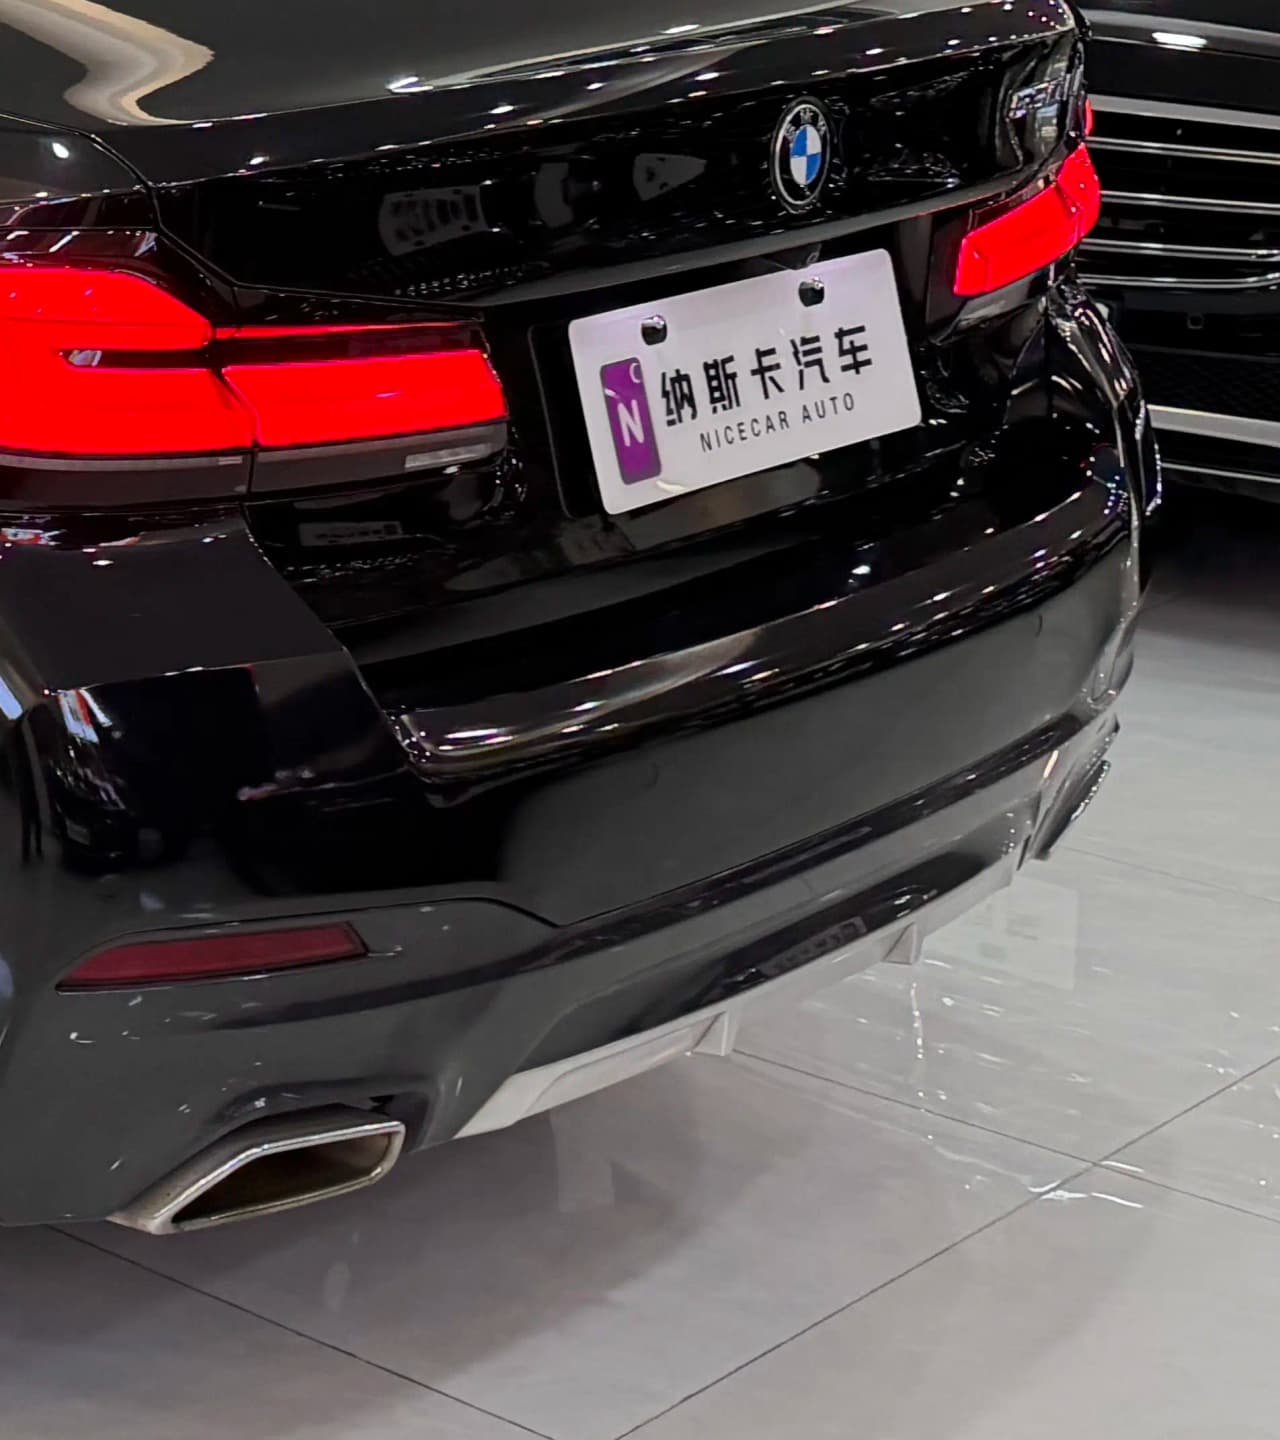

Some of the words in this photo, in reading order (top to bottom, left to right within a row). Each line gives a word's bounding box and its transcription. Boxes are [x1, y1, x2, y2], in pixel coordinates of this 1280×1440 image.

[661, 324, 873, 427] 纳斯卡汽车
[700, 409, 791, 453] NICECAR
[801, 392, 856, 424] AUTO
